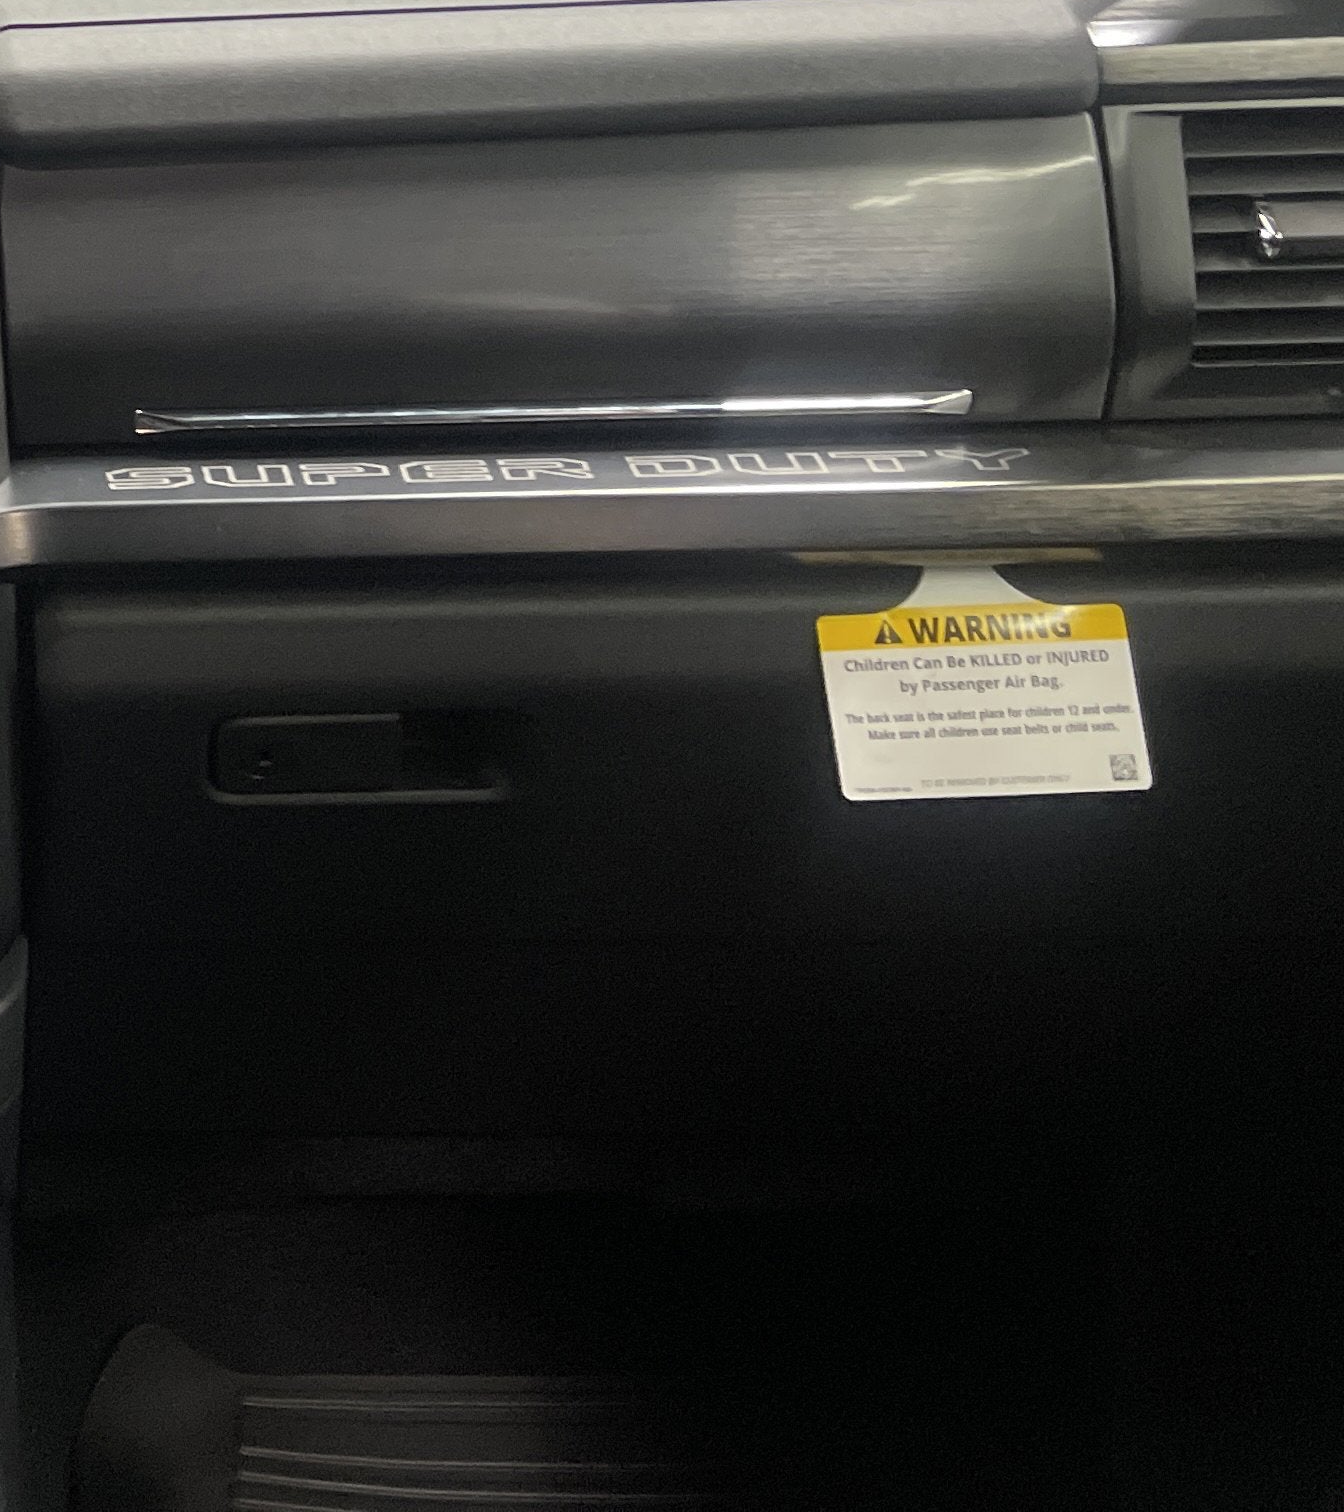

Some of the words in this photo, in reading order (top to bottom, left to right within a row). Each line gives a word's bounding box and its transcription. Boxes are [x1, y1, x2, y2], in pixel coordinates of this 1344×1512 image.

[105, 454, 593, 492] SUPER
[630, 446, 1031, 482] DUTY
[908, 613, 1072, 644] WARNING
[844, 657, 910, 672] Children
[913, 656, 943, 670] Can
[947, 655, 967, 668] Be
[969, 653, 1022, 667] KILLED
[1026, 654, 1042, 665] or
[1046, 649, 1110, 666] INJURED
[899, 680, 918, 696] by
[922, 677, 1000, 694] Passenger
[1004, 675, 1026, 689] Air
[1031, 674, 1064, 690] Bag.
[845, 713, 865, 725] The
[867, 712, 890, 724] back
[917, 711, 925, 722] is
[928, 710, 944, 721] the
[947, 709, 977, 721] safest
[980, 709, 1005, 722] place
[1008, 707, 1022, 719] for
[1025, 706, 1065, 718] children
[1068, 705, 1080, 717] 12
[1082, 704, 1100, 716] and
[868, 729, 896, 741] Make
[899, 730, 920, 740] sure
[924, 728, 936, 738] all
[938, 726, 979, 738] children
[981, 727, 999, 737] use
[1001, 725, 1022, 736] seat
[1025, 724, 1049, 735] belts
[1052, 724, 1062, 734] or
[1065, 722, 1088, 733] child
